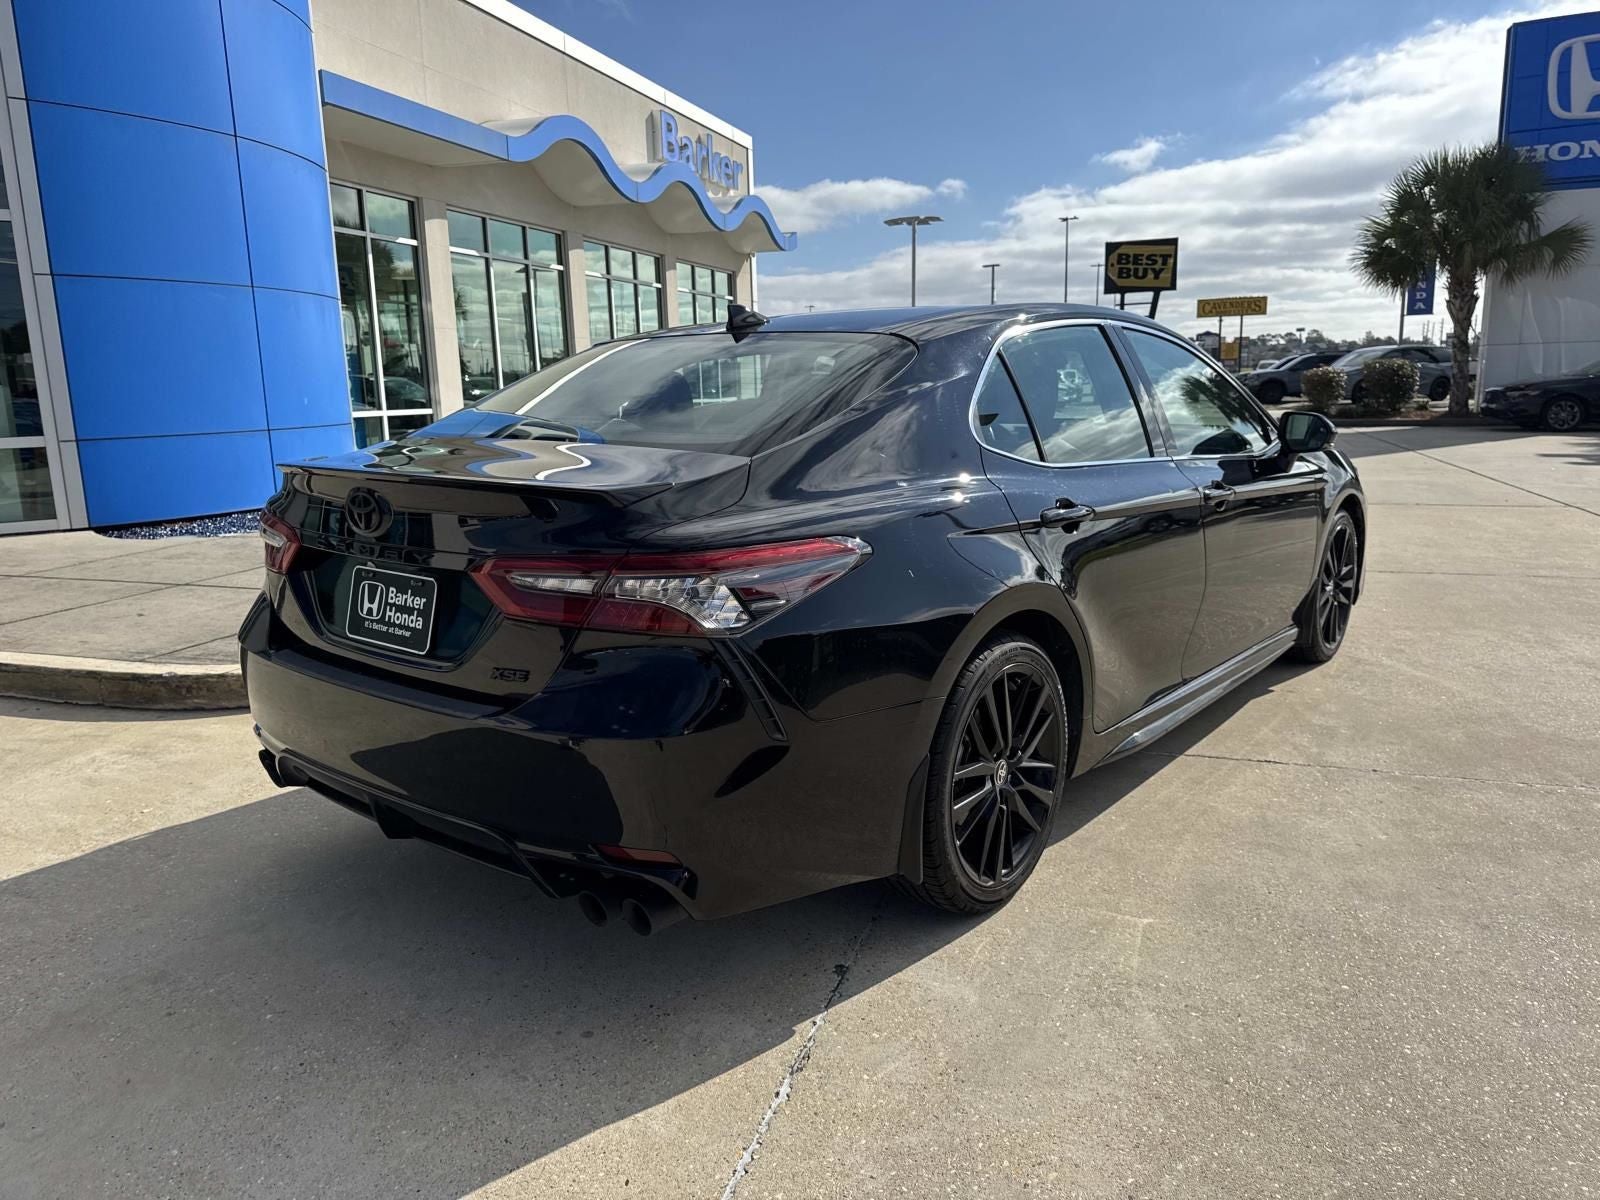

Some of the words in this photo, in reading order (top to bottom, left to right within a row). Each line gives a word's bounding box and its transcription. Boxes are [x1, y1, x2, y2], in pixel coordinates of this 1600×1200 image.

[660, 109, 743, 191] Barker
[1116, 253, 1172, 266] BEST
[1117, 267, 1167, 280] BUY
[1413, 280, 1428, 310] NDA
[388, 586, 427, 610] Barker
[385, 605, 423, 629] Honda
[364, 620, 372, 629] It's
[372, 622, 388, 632] Better
[388, 626, 395, 634] at
[394, 627, 412, 638] Barker
[490, 667, 530, 682] XSE
